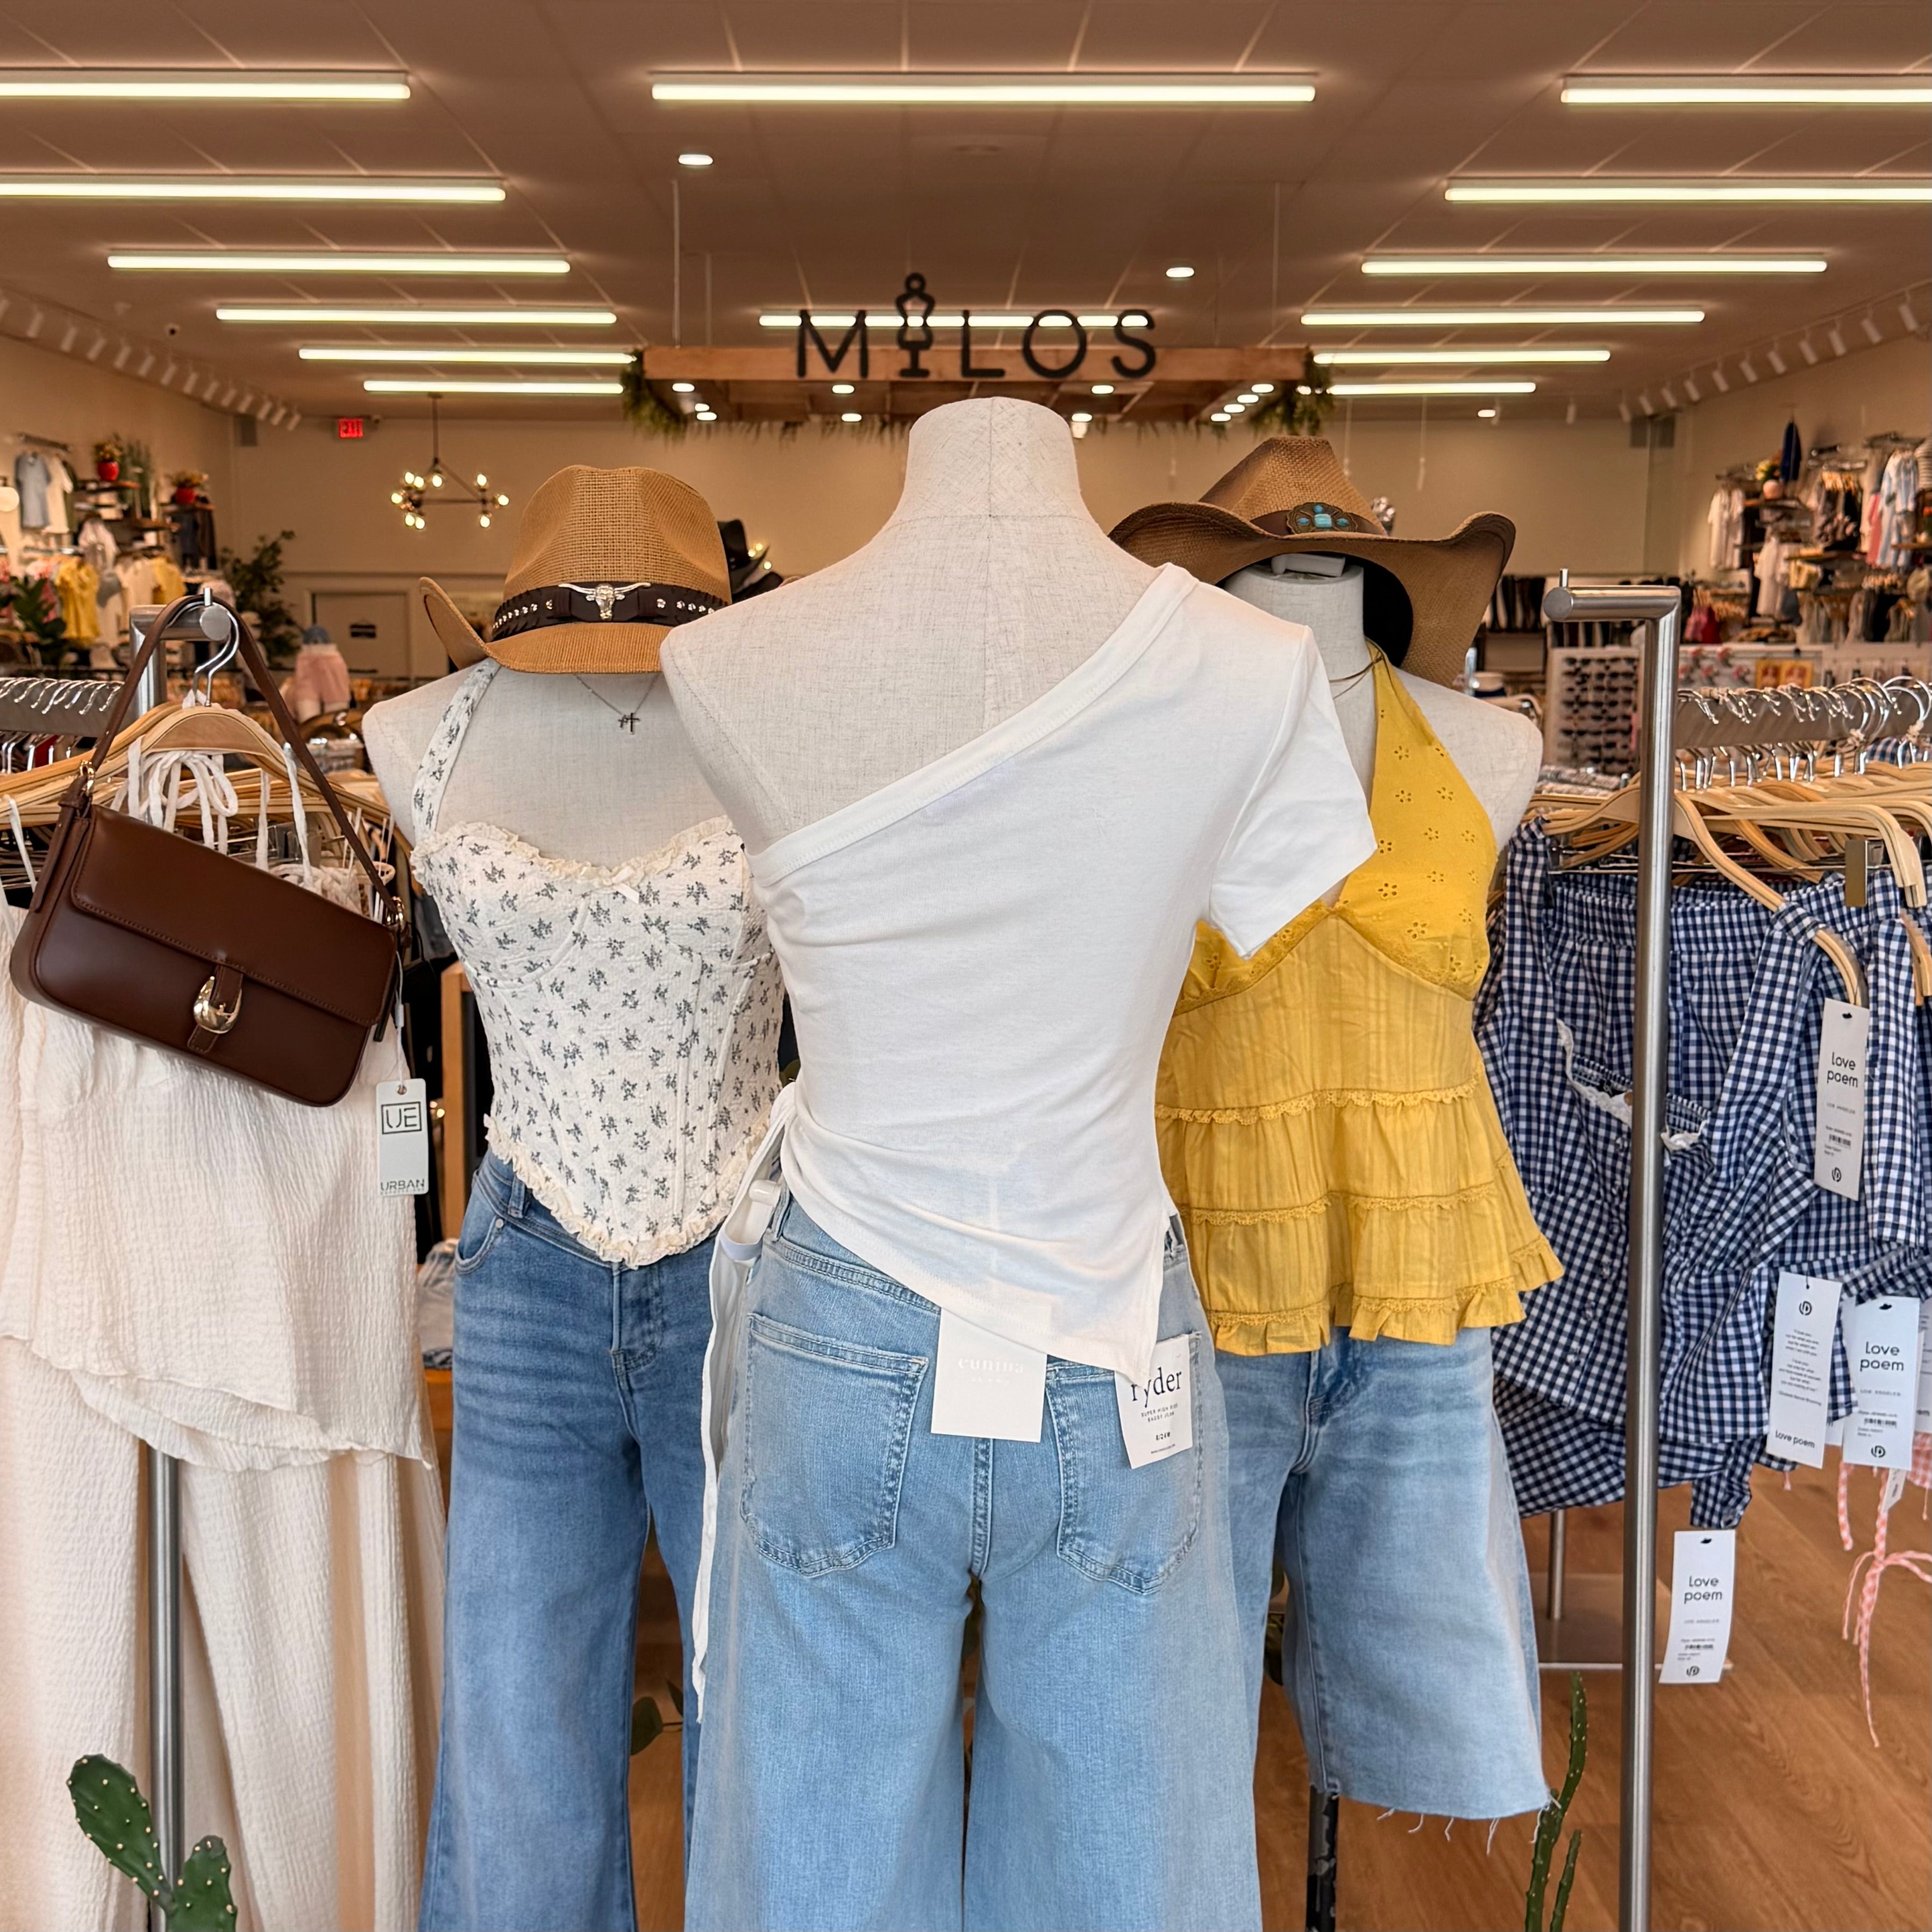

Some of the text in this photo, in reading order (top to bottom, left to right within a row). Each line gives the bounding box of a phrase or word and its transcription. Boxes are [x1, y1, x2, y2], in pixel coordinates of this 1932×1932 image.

[796, 272, 1157, 379] MILOS
[1827, 1070, 1858, 1088] poem
[386, 1107, 417, 1129] UE
[381, 1179, 424, 1190] URBAN
[1860, 1359, 1904, 1372] poem
[1131, 1366, 1182, 1408] ryder
[1793, 1436, 1815, 1448] poem
[1684, 1591, 1722, 1604] poem
